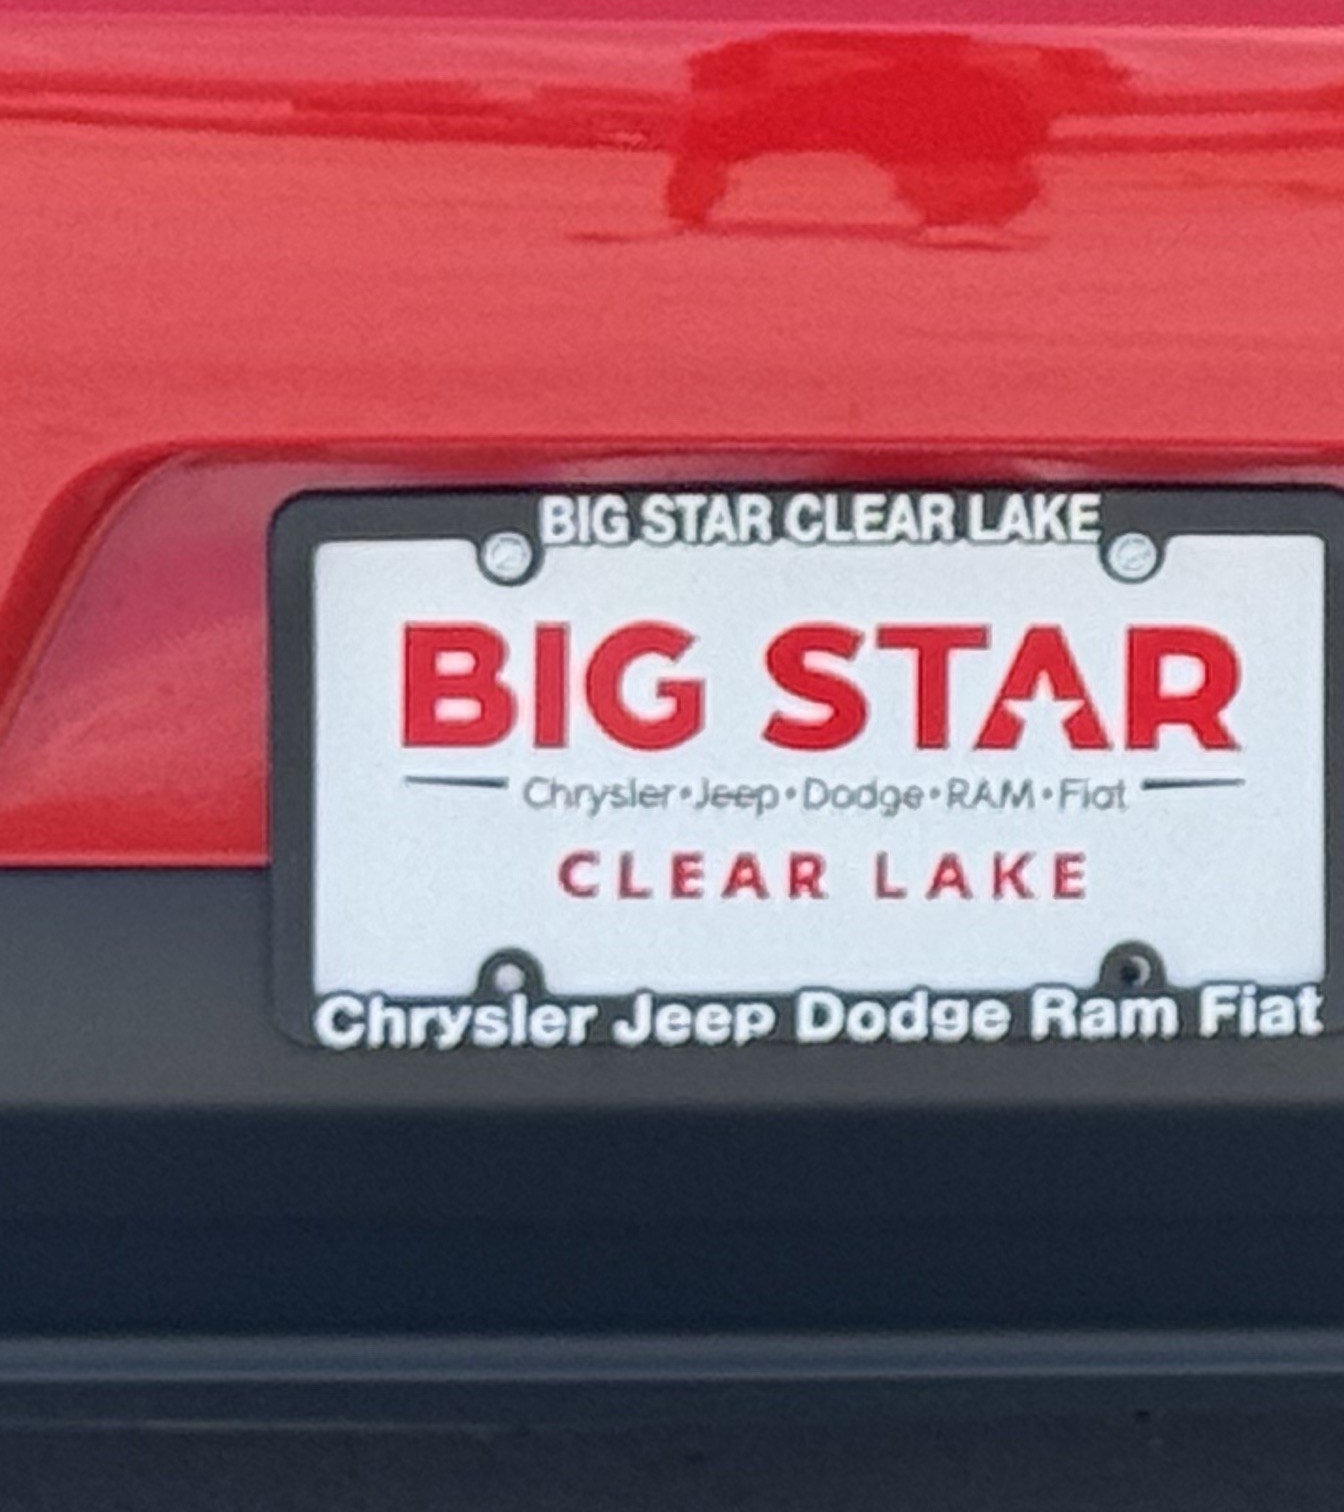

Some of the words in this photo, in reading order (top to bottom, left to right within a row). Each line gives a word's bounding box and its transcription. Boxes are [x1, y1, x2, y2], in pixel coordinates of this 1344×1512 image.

[543, 494, 630, 544] BIG
[643, 494, 772, 543] STAR
[783, 493, 957, 543] CLEAR
[970, 492, 1103, 542] LAKE
[402, 622, 705, 750] BIG
[761, 622, 1241, 751] STAR
[522, 776, 675, 816] Chrysler
[692, 777, 781, 816] Jeep
[802, 776, 925, 817] Dodge
[946, 777, 1036, 810] RAM
[1058, 776, 1128, 811] Fiat
[557, 851, 827, 901] CLEAR
[874, 850, 1087, 900] LAKE
[316, 994, 597, 1048] Chrysler
[611, 993, 777, 1047] Jeep
[798, 990, 1010, 1041] Dodge
[1030, 990, 1179, 1039] Ram
[1199, 986, 1325, 1037] Fiat
